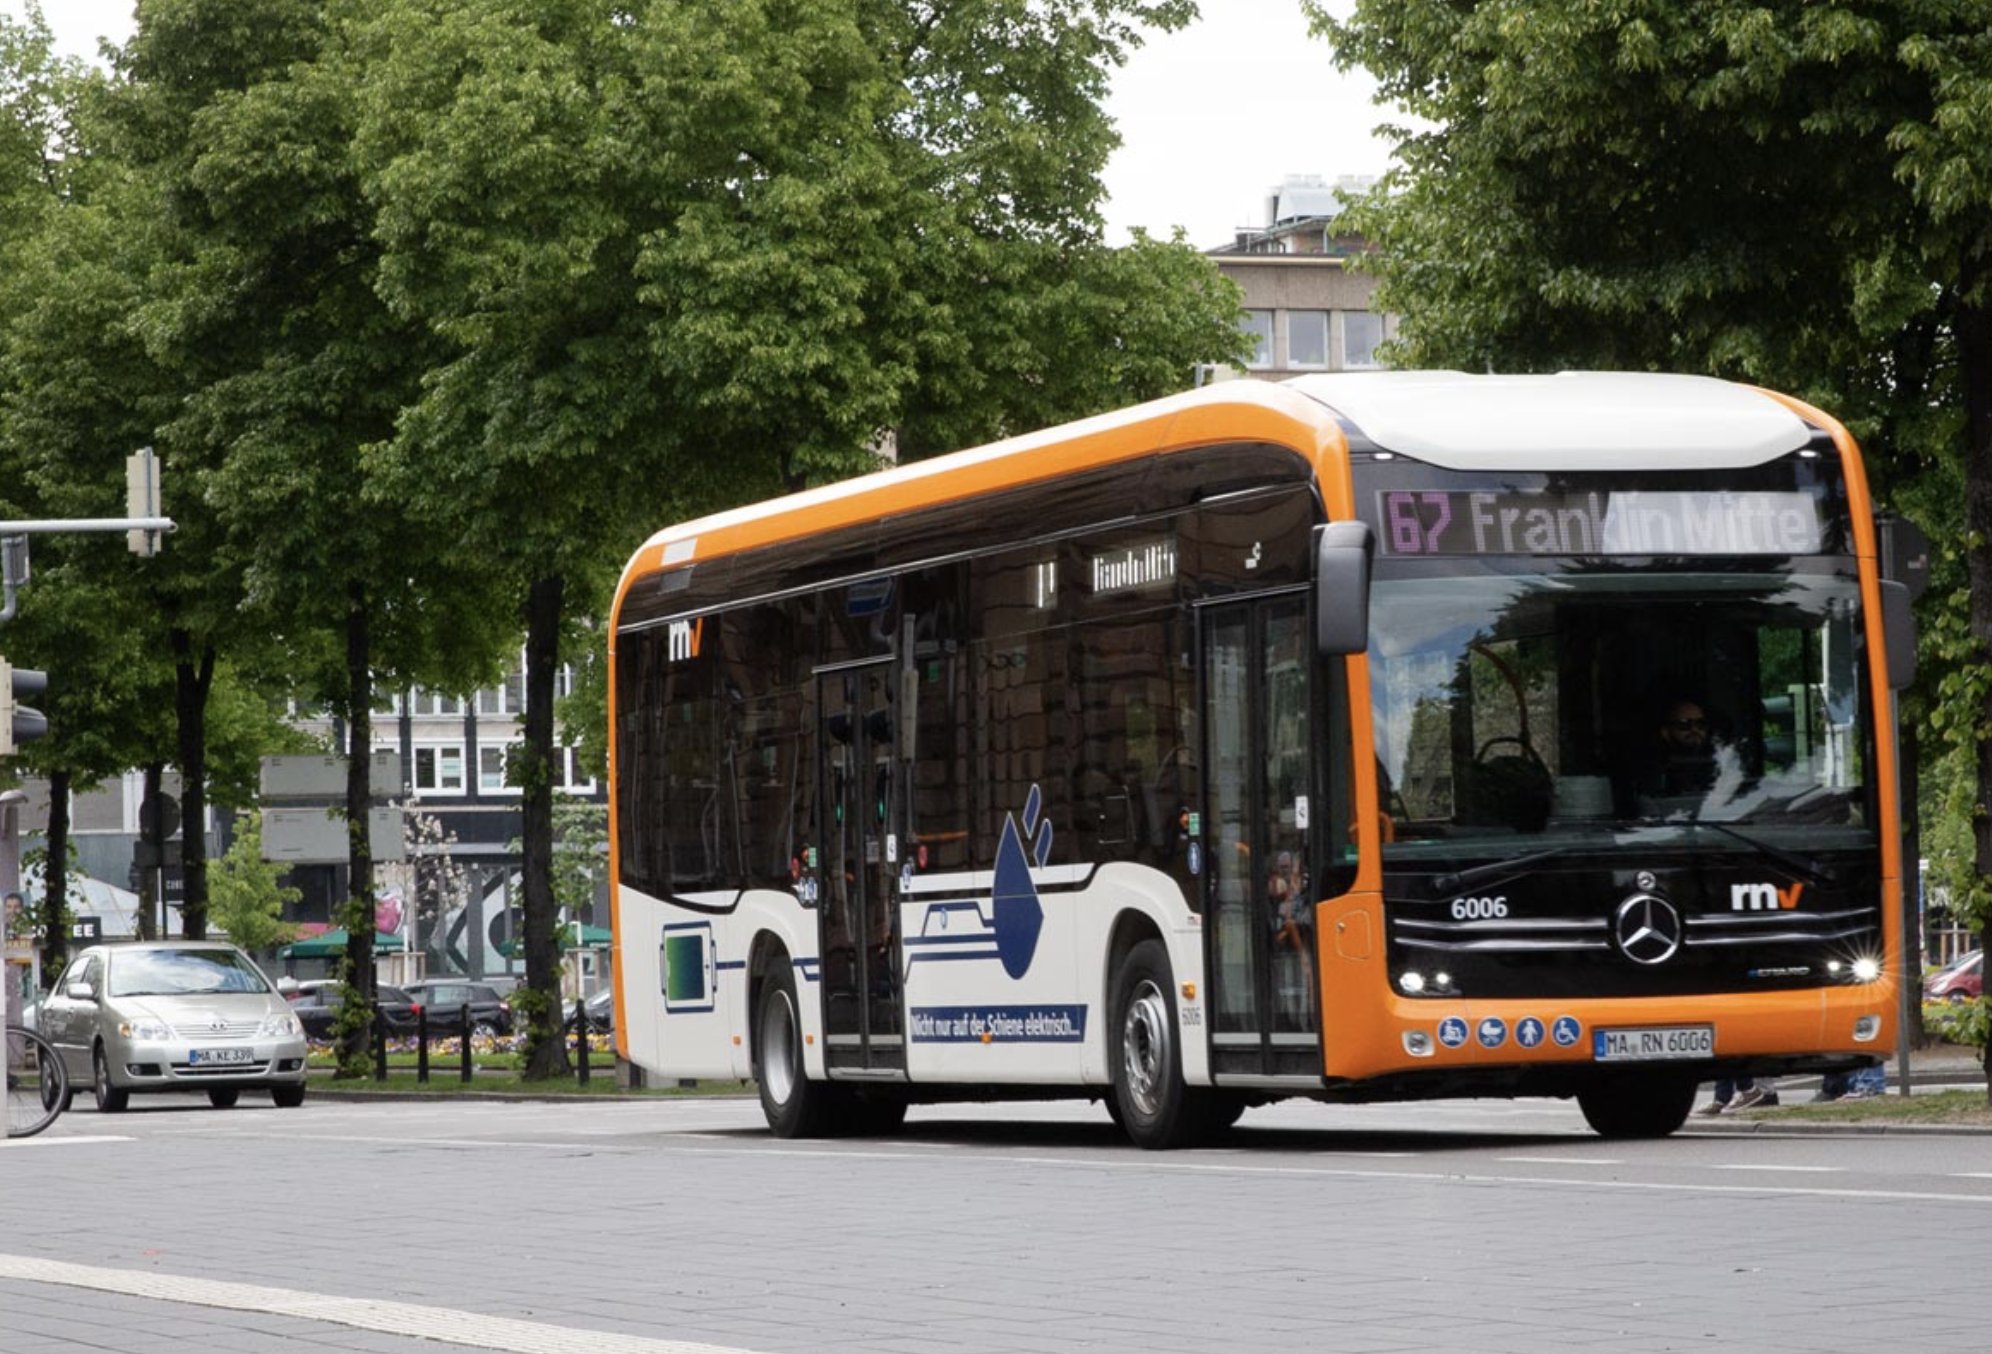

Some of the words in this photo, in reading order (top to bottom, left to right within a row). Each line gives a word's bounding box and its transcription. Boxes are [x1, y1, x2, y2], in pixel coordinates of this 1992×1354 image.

[1388, 490, 1452, 553] 67
[1470, 490, 1674, 553] Franklin
[1680, 491, 1809, 553] Mitte
[1451, 896, 1509, 919] 6006
[1731, 881, 1804, 910] rnv
[1607, 1034, 1628, 1054] MA
[1641, 1032, 1664, 1053] RN
[1667, 1031, 1710, 1051] 6006
